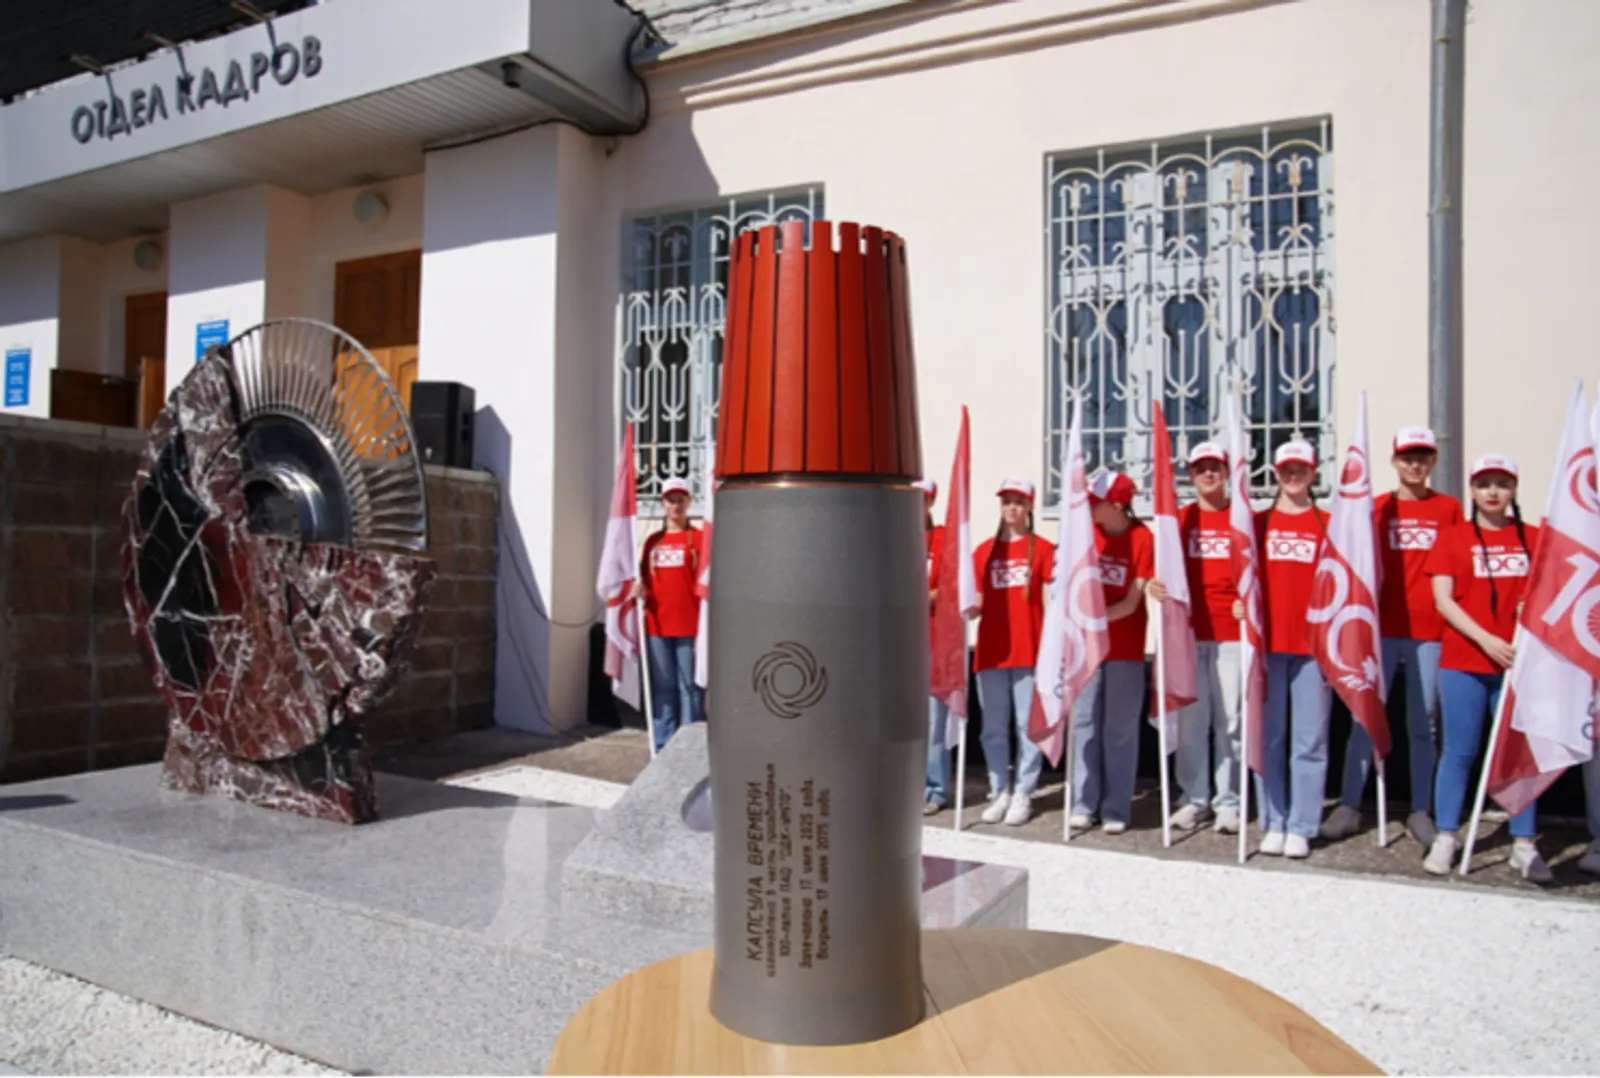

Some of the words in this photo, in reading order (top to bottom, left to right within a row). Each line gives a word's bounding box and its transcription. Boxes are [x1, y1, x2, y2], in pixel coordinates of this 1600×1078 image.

[71, 84, 168, 144] ОТДЕЛ
[175, 35, 323, 114] КАДРОВ
[746, 782, 763, 865] ВРЕМЕНИ
[798, 813, 813, 841] 2025
[779, 868, 792, 893] ПАО
[798, 879, 813, 890] 17
[746, 876, 763, 961] КАПСУЛА
